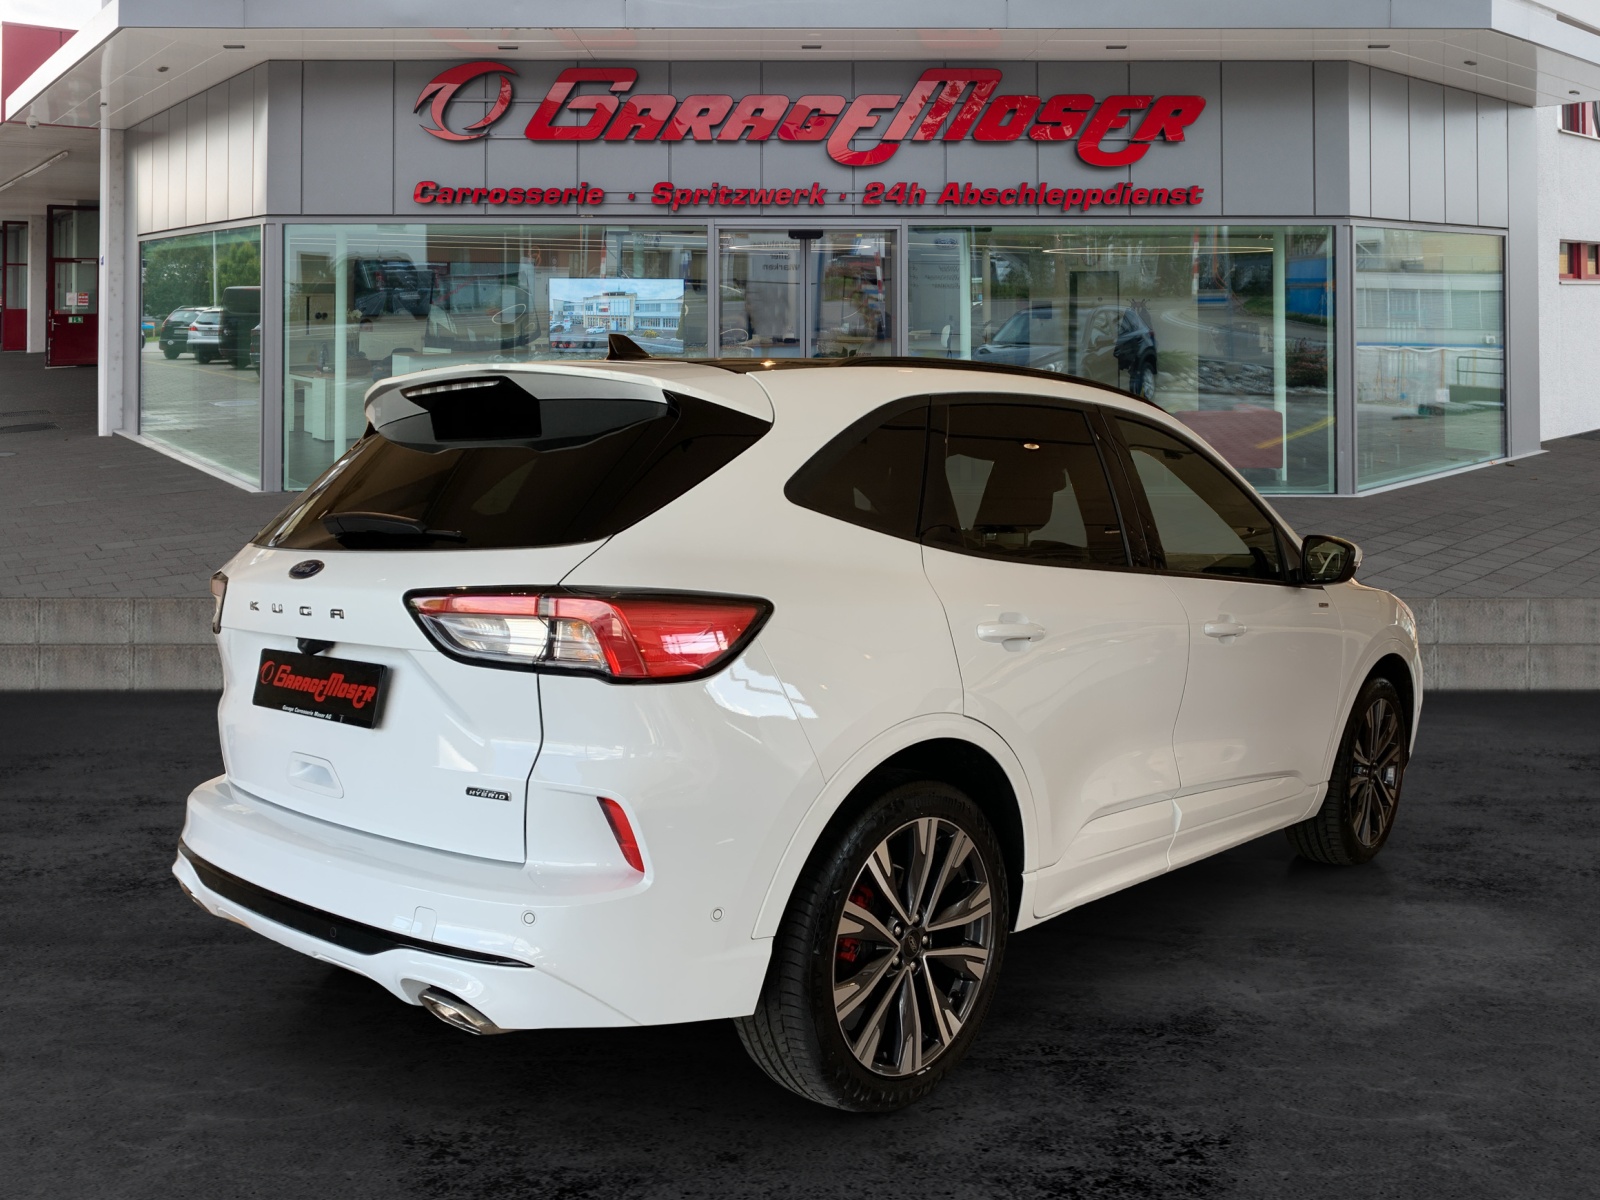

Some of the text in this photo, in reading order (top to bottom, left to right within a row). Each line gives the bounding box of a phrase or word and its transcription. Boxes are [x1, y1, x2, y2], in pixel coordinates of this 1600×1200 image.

[413, 180, 1204, 212] Carrosserie Spritzwerk 24h Abschleppdienst
[250, 601, 345, 619] KUGA
[469, 790, 506, 799] HYBRID
